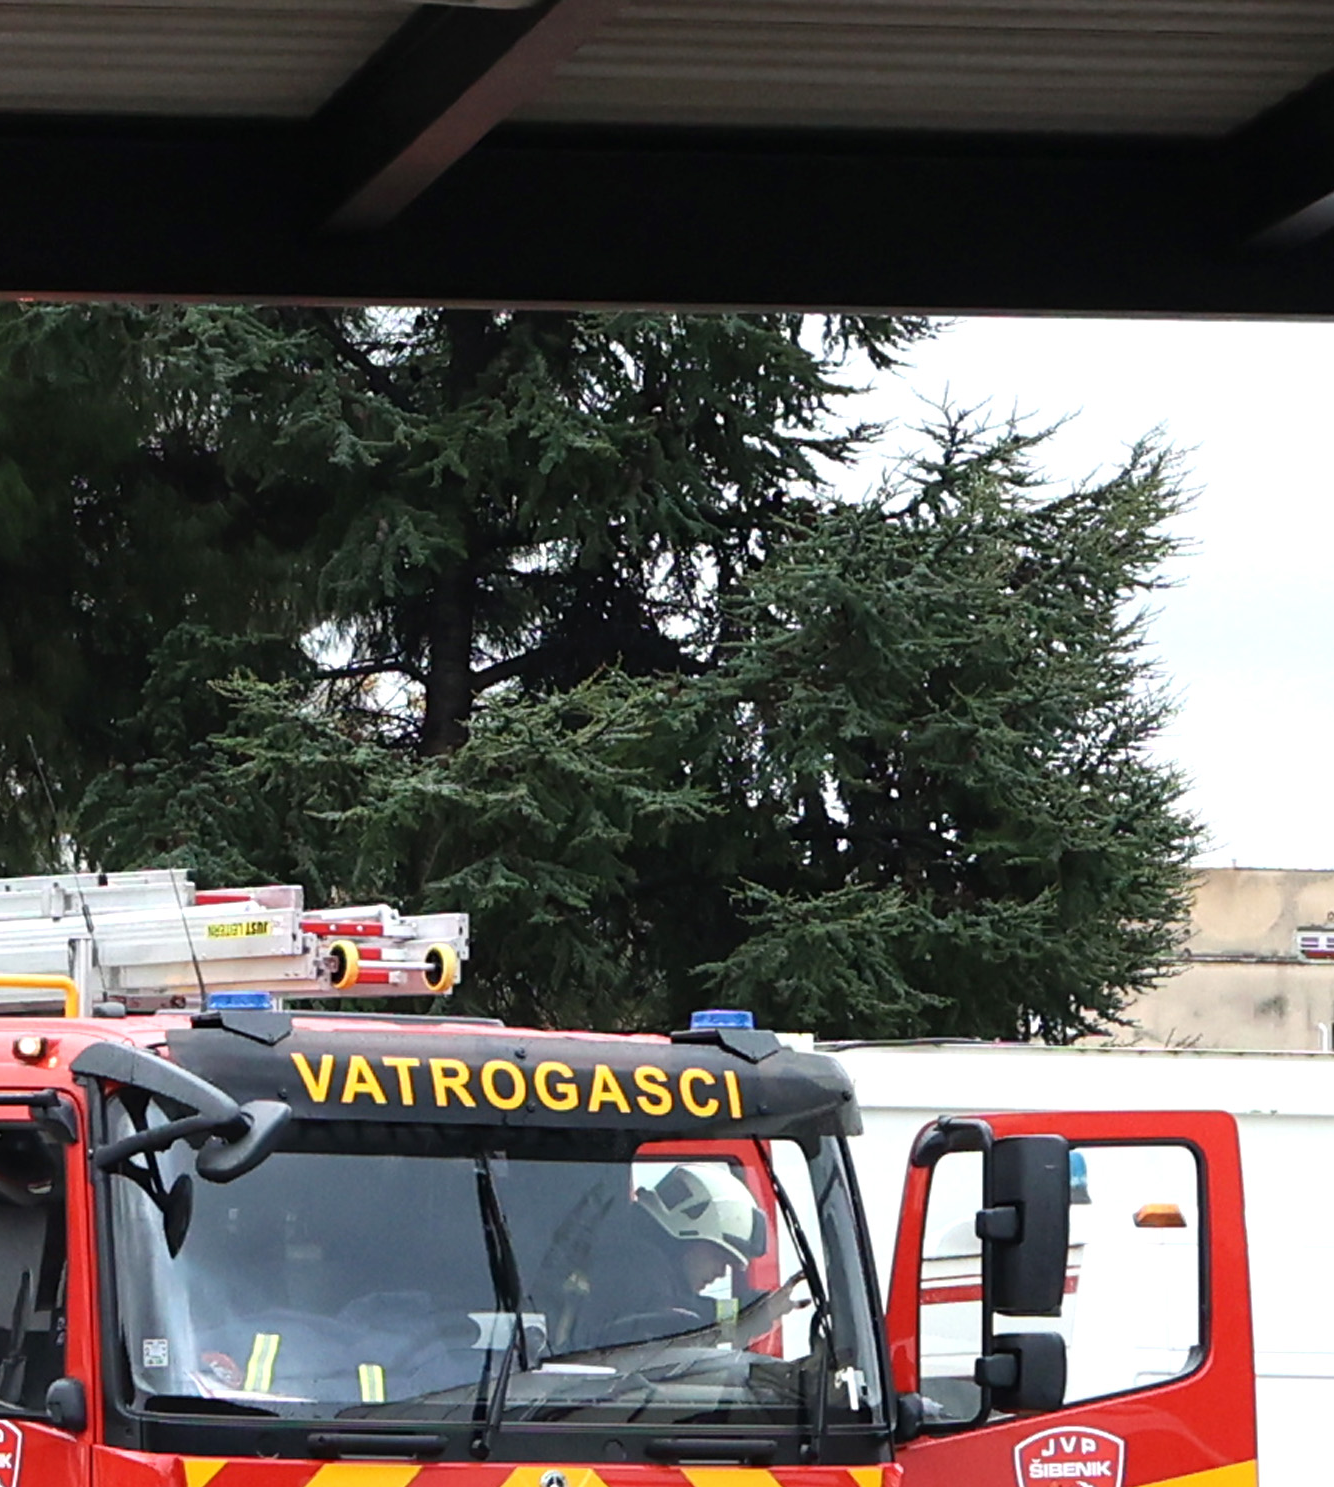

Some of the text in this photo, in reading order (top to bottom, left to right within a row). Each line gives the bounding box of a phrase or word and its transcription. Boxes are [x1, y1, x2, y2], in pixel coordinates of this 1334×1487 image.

[290, 1052, 744, 1120] VATROGASCI
[1041, 1436, 1097, 1457] JVP
[1029, 1458, 1112, 1479] ŠIBENIK
